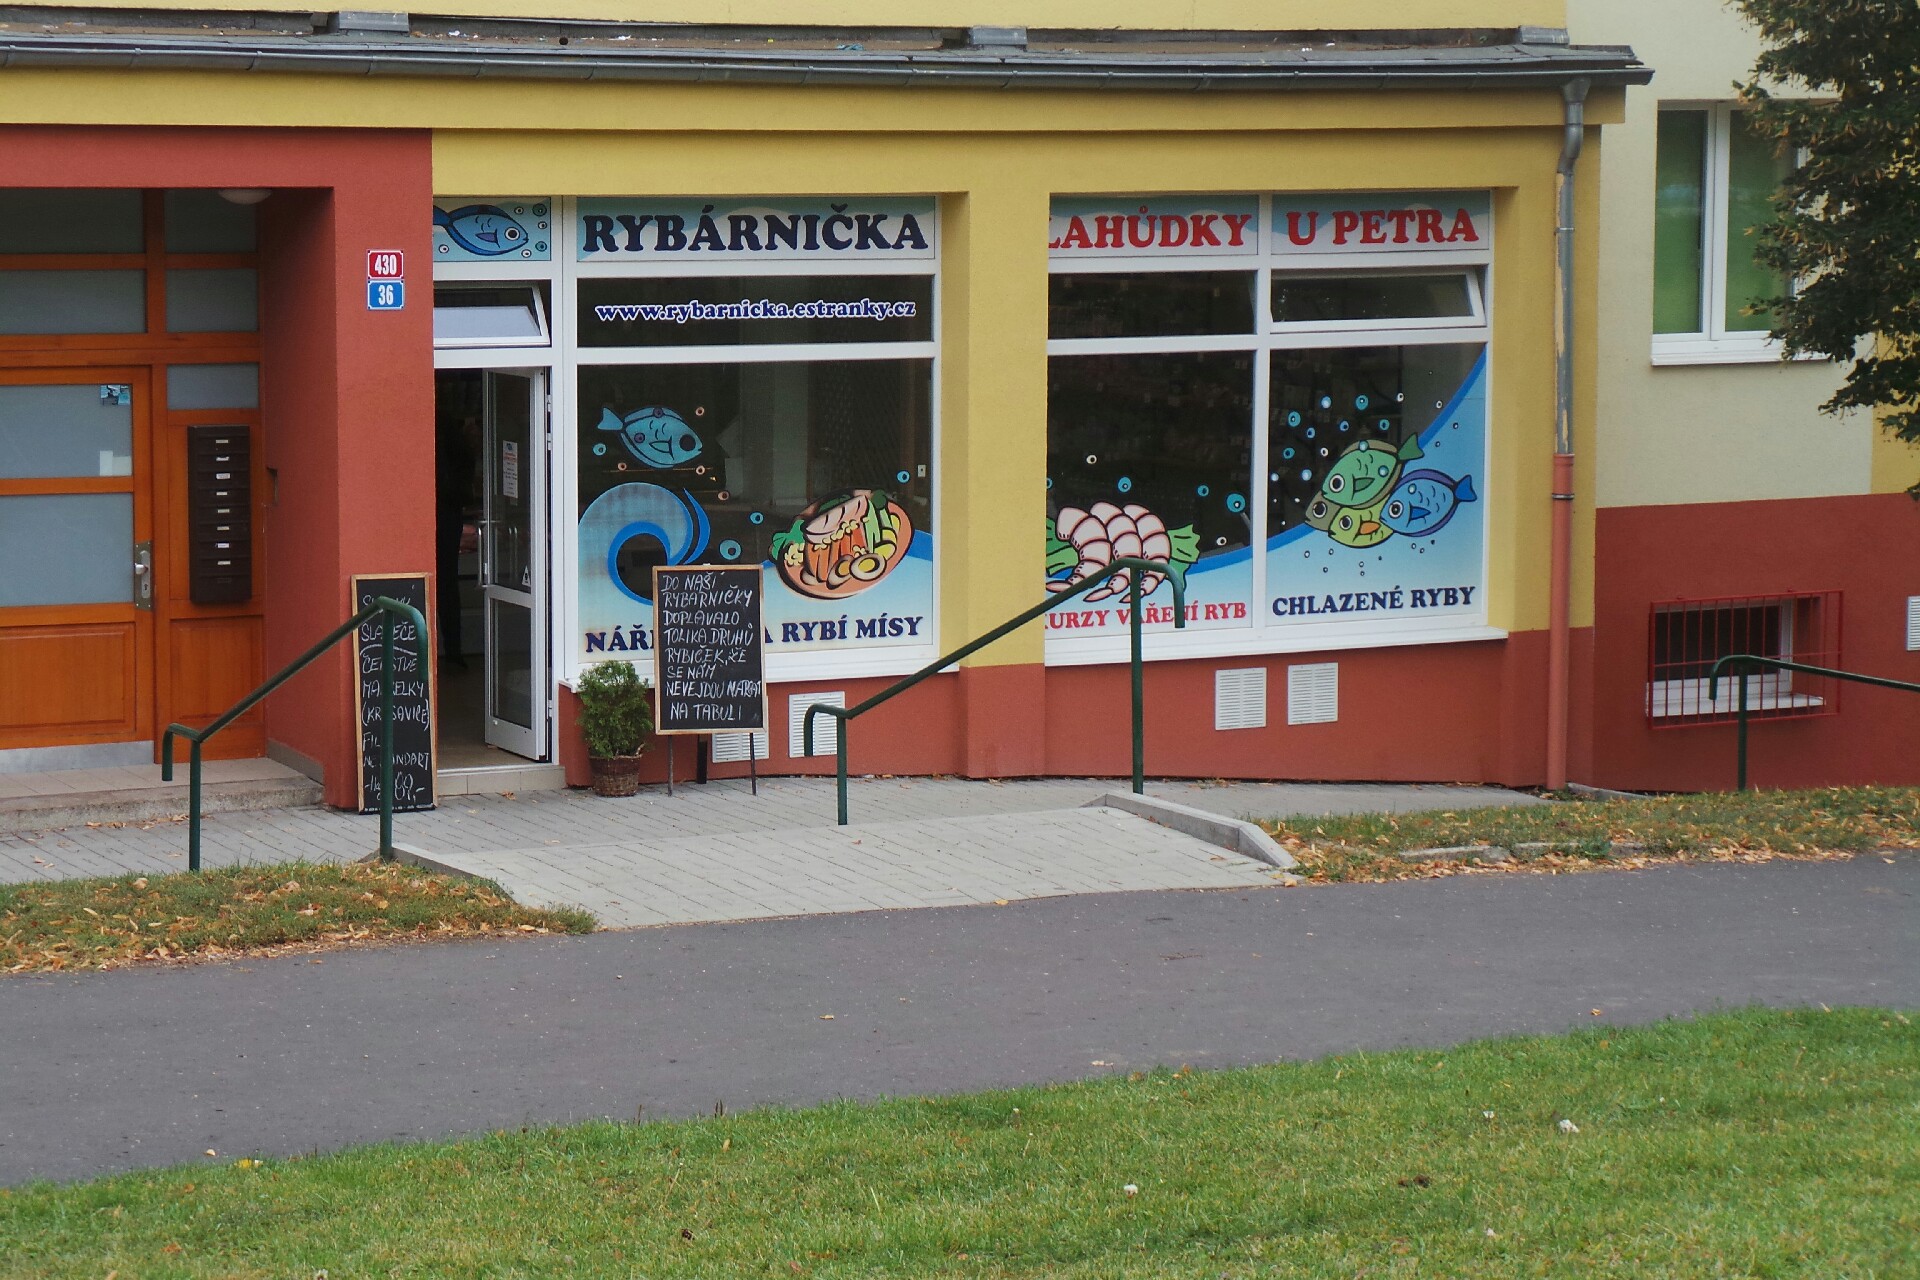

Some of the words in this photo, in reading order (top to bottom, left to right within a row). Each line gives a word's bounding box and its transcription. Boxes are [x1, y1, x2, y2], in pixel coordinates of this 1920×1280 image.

[582, 203, 929, 252] RYBÁRNIČKA
[1285, 210, 1319, 246] U
[1332, 207, 1480, 246] PETRA
[374, 254, 397, 275] 430
[378, 284, 394, 305] 36
[595, 298, 917, 324] www.rybarnicka.estranky.cz
[661, 575, 680, 592] DO
[1204, 602, 1247, 620] RYB
[1272, 585, 1404, 617] CHLAZENÉ
[1410, 586, 1476, 608] RYBY
[662, 610, 740, 626] DOPLAVALO
[781, 614, 848, 643] RYBÍ
[855, 612, 924, 639] MÍSY
[663, 628, 708, 645] TOLIKA
[667, 666, 684, 678] SE
[670, 702, 689, 721] NA
[693, 703, 742, 721] TABULI
